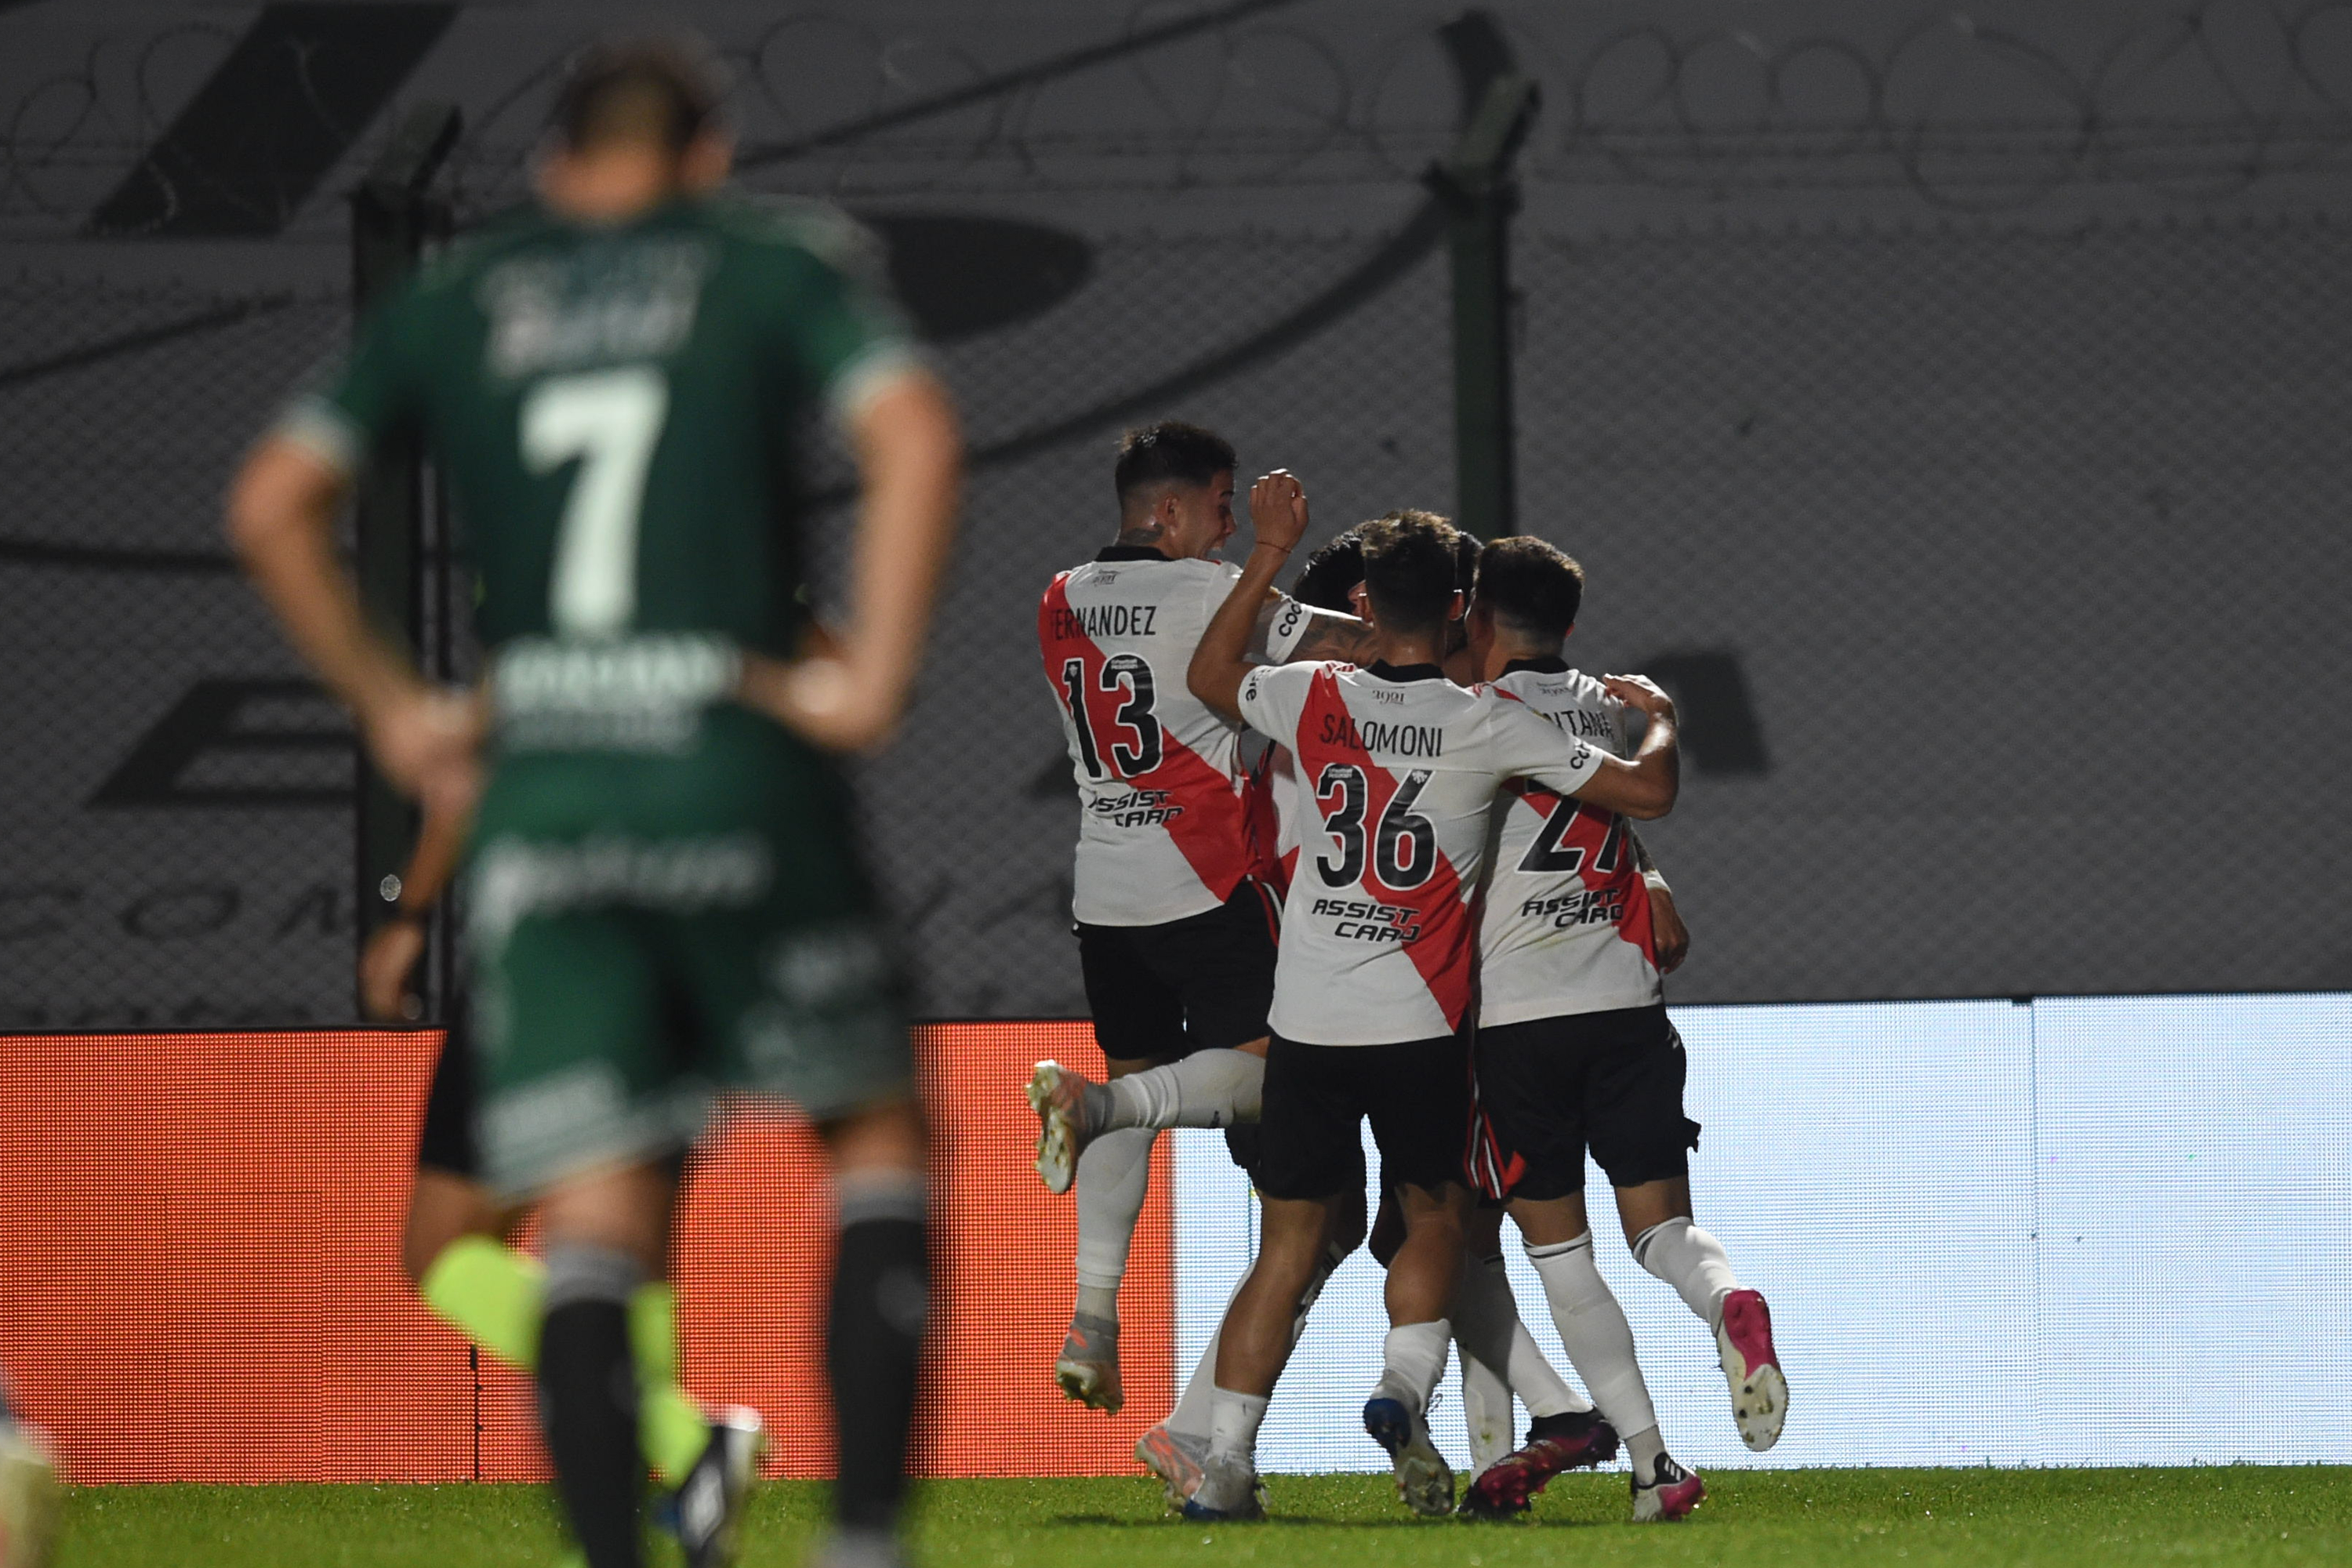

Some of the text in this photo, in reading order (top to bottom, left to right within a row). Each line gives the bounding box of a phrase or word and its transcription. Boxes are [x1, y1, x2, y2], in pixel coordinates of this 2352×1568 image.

[517, 363, 671, 635] 7
[1051, 604, 1156, 641] FERNANDEZ
[1062, 652, 1163, 779] 13
[1319, 714, 1443, 757] SALOMONI
[1316, 763, 1438, 891] 36
[1312, 898, 1421, 924] ASSIST
[1522, 888, 1620, 916] ASSIST
[1555, 904, 1624, 927] CARD
[1334, 921, 1421, 942] CARD
